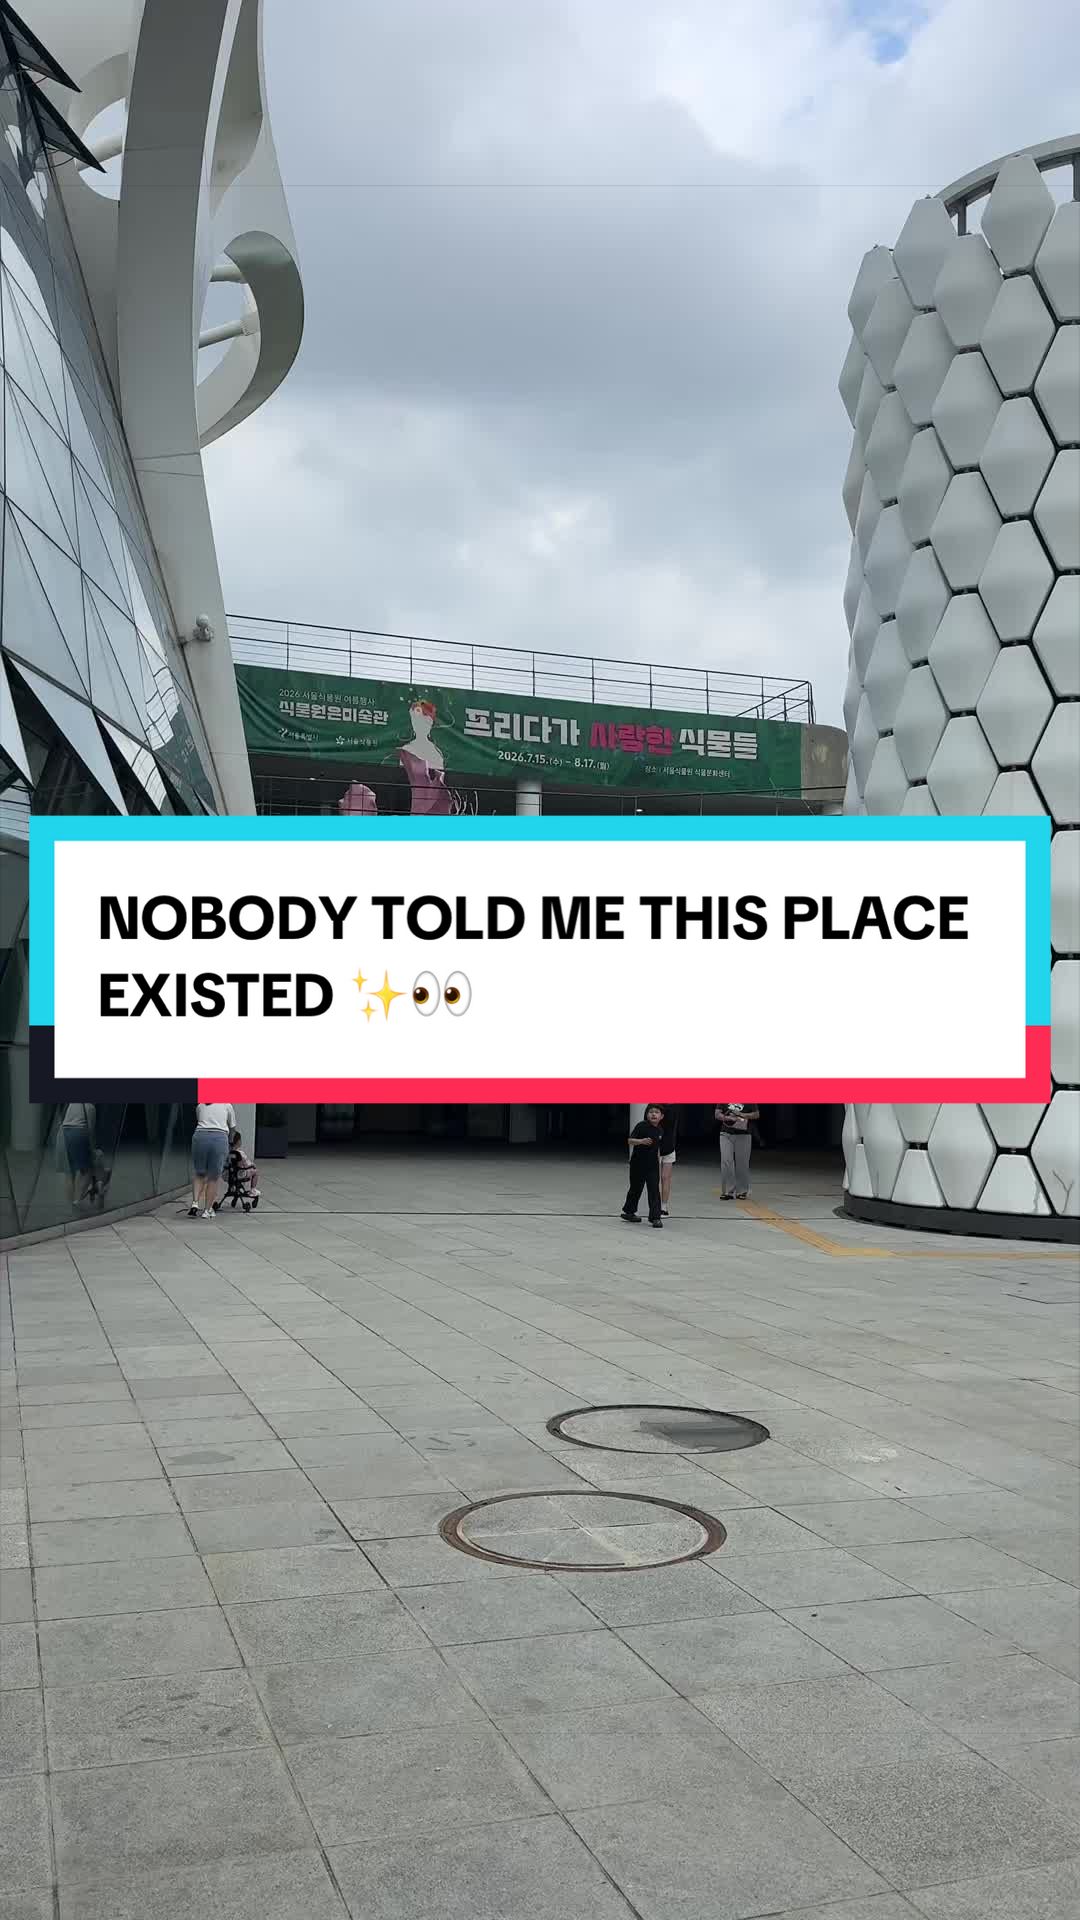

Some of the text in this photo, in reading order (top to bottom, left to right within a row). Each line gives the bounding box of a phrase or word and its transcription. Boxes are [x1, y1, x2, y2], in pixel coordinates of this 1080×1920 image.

[279, 688, 300, 698] 2026
[463, 707, 758, 760] 프리다가 사랑한 식물들
[497, 750, 563, 767] 2026.7.15.(수)
